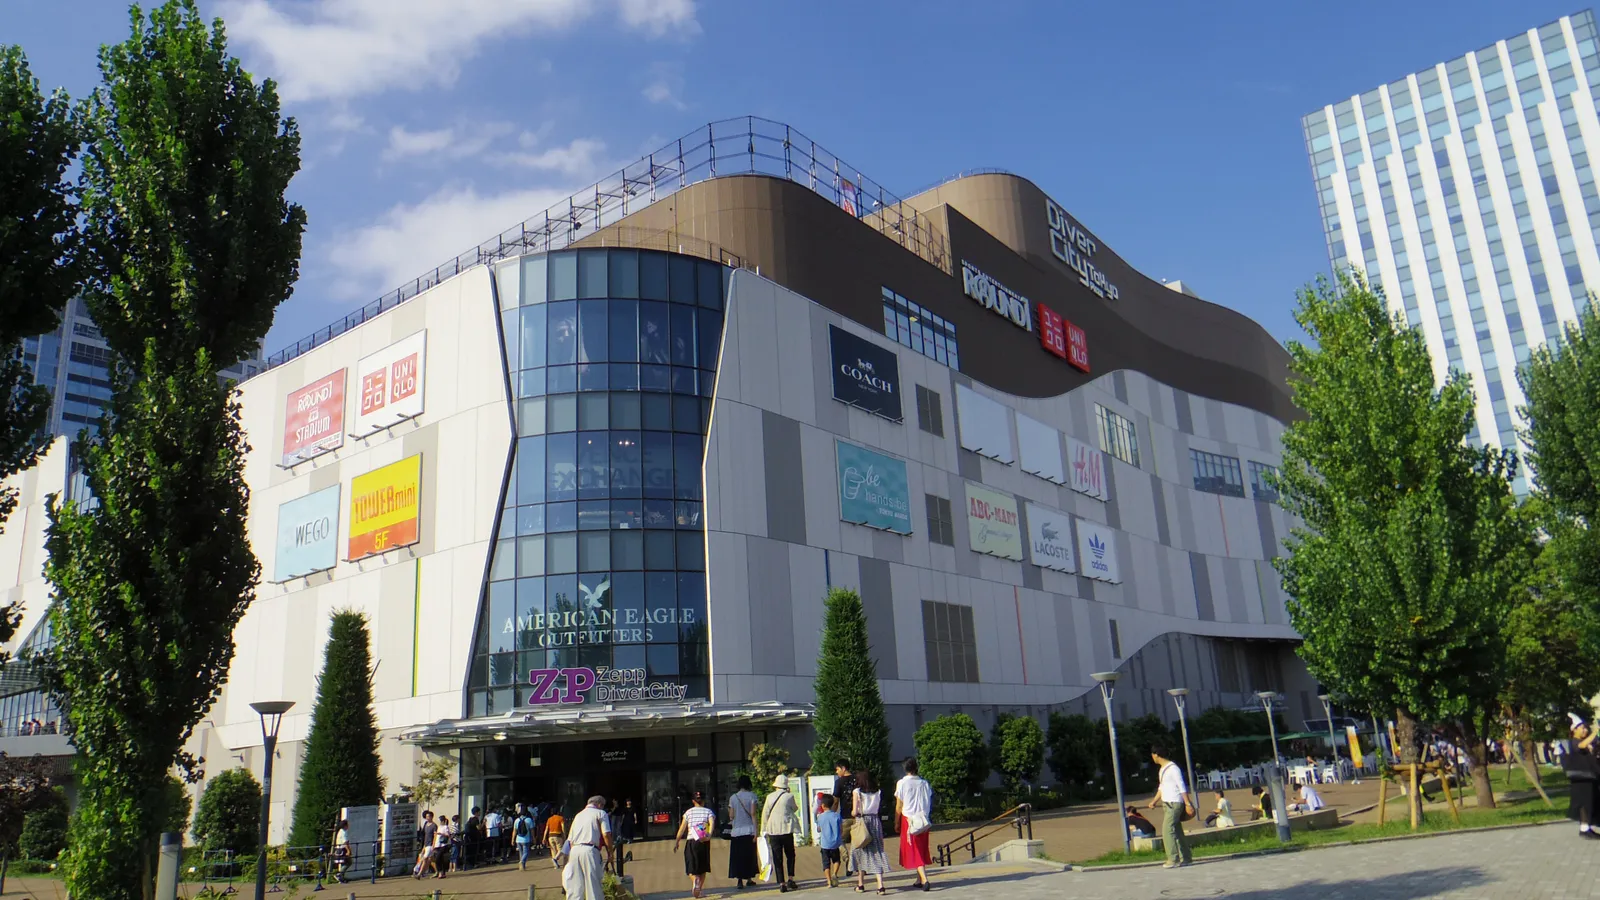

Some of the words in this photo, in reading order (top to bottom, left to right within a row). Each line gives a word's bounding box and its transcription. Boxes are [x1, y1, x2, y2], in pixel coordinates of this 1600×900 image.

[1046, 199, 1097, 257] Diver
[1050, 228, 1089, 287] City
[1068, 326, 1085, 345] UNI
[1071, 344, 1087, 365] QLO
[394, 359, 413, 380] UNI
[841, 364, 892, 393] COACH
[393, 376, 414, 398] QLO
[295, 415, 331, 443] STADIUM
[1072, 443, 1101, 497] H&M
[970, 497, 1017, 526] ABC-MART
[295, 516, 330, 548] WEGO
[375, 530, 390, 550] 5F
[1034, 541, 1070, 561] LACOSTE
[1091, 561, 1109, 572] adidas
[502, 608, 617, 634] AMERICAN
[624, 608, 695, 625] EAGLE
[538, 628, 654, 648] OUTFITTERS
[528, 667, 595, 705] ZP
[596, 666, 647, 685] Zepp
[596, 682, 688, 703] DiverCity
